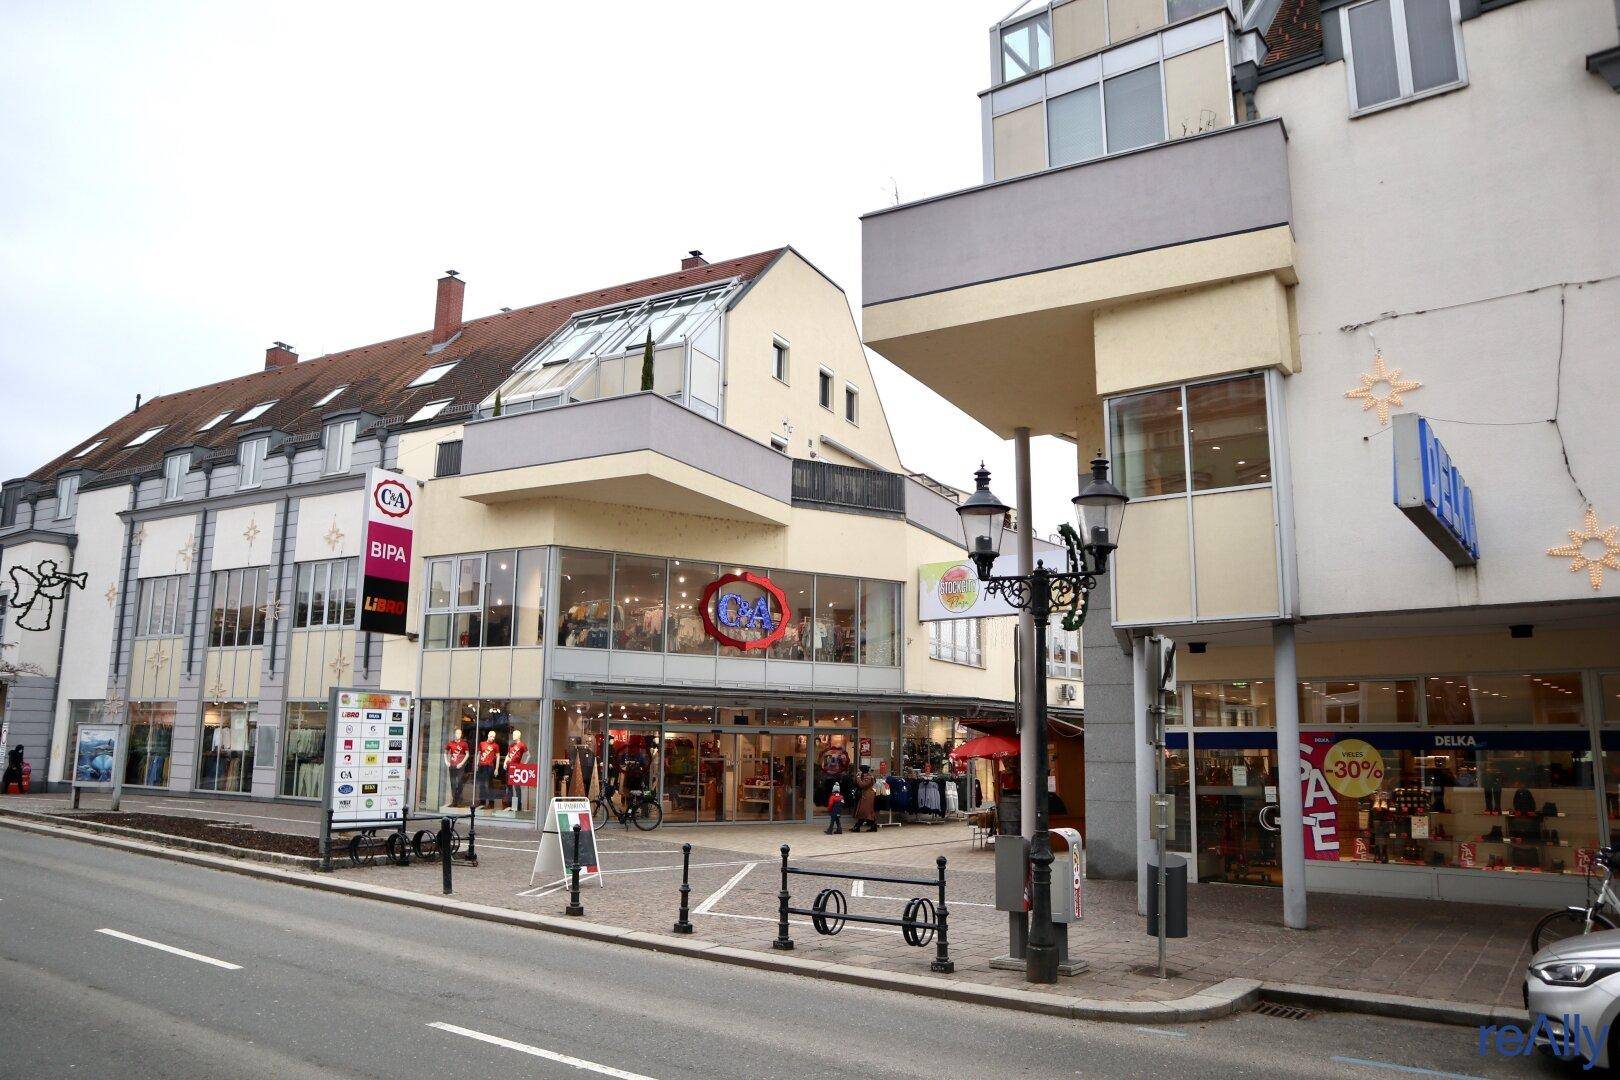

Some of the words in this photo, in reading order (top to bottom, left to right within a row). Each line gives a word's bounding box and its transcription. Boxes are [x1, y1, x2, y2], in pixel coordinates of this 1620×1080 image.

[381, 488, 406, 510] C&A
[370, 541, 406, 563] BIPA
[717, 592, 774, 632] C&A
[1434, 735, 1476, 747] DELKA
[1325, 760, 1383, 779] -30%
